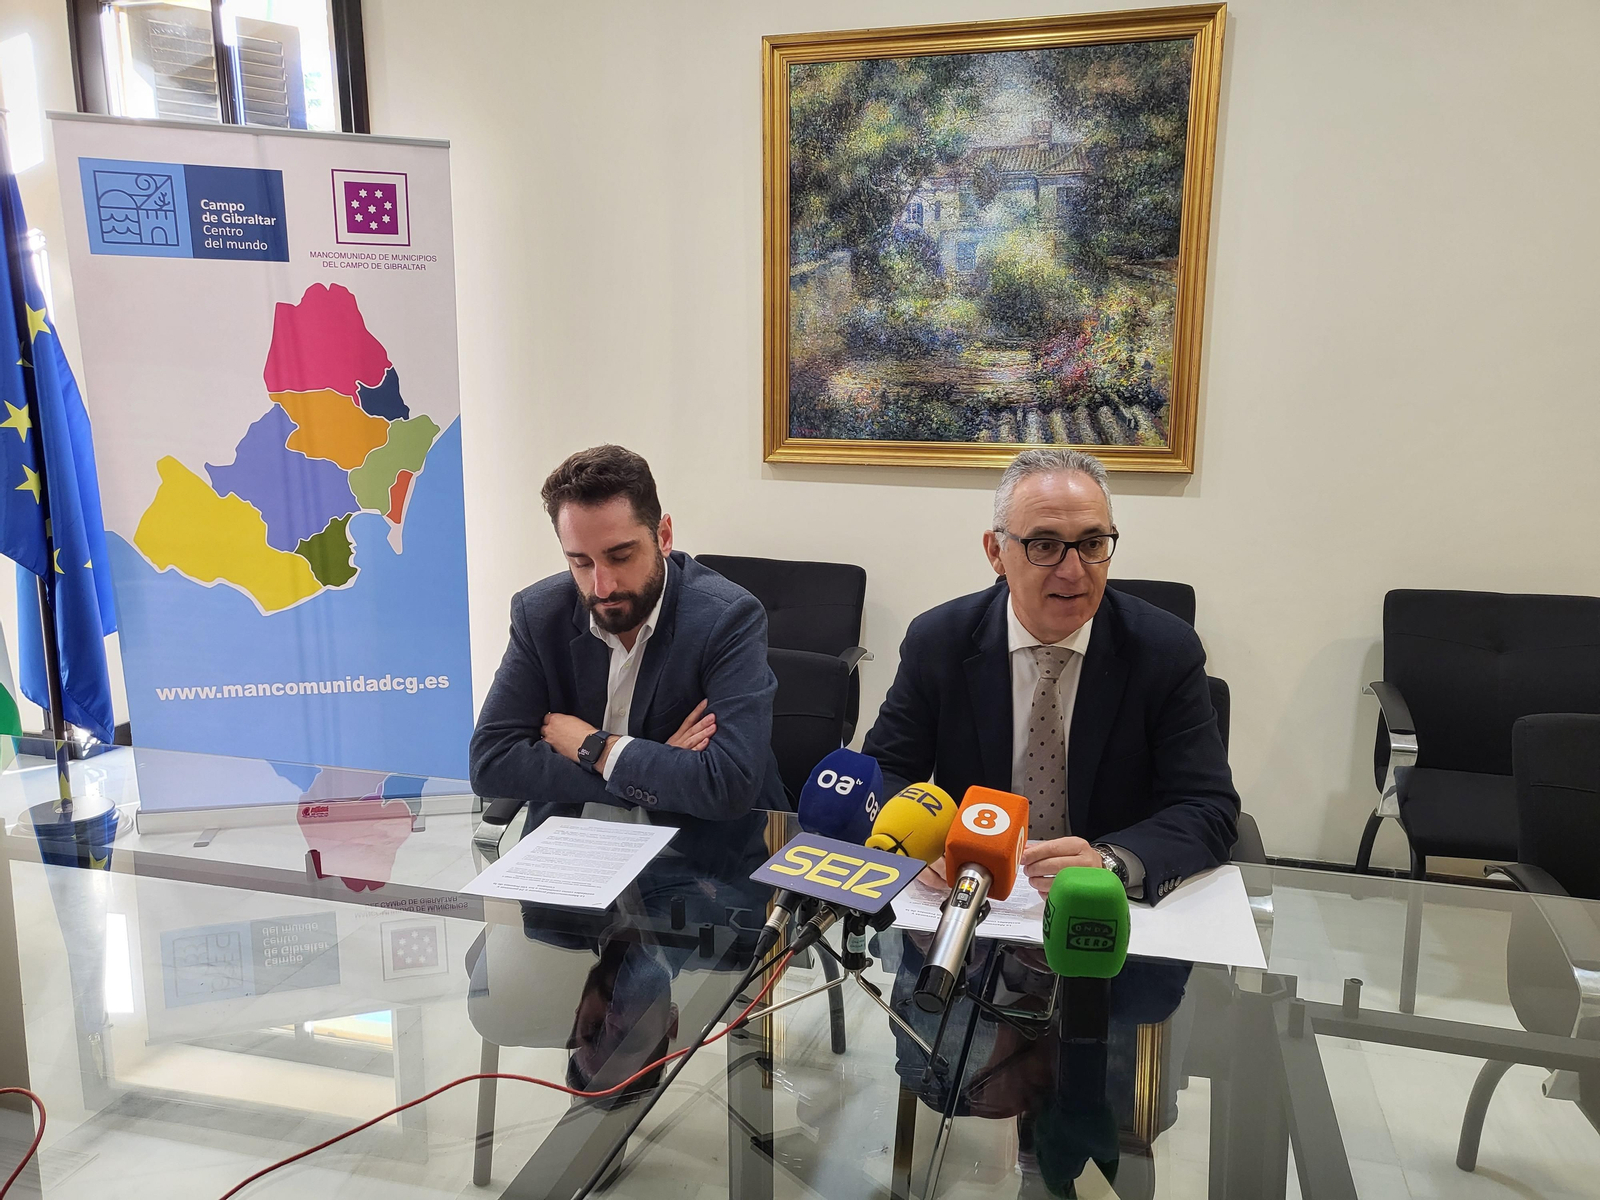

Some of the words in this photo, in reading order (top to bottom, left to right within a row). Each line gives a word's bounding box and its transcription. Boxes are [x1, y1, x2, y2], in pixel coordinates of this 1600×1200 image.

[200, 199, 245, 212] Campo
[202, 212, 218, 223] de
[221, 213, 276, 226] Gibraltar
[203, 225, 244, 237] Centro
[204, 238, 223, 249] del
[226, 240, 268, 251] mundo
[309, 251, 377, 260] MANCOMUNIDAD
[378, 253, 390, 261] DE
[391, 254, 437, 262] MUNICIPIOS
[339, 261, 370, 269] CAMPO
[371, 262, 382, 270] DE
[383, 263, 427, 271] GIBRALTAR
[155, 674, 450, 701] www.mancomunidadcg.es
[894, 787, 943, 817] ER
[973, 809, 998, 829] 8
[769, 845, 900, 899] SER
[1075, 938, 1108, 947] CERO
